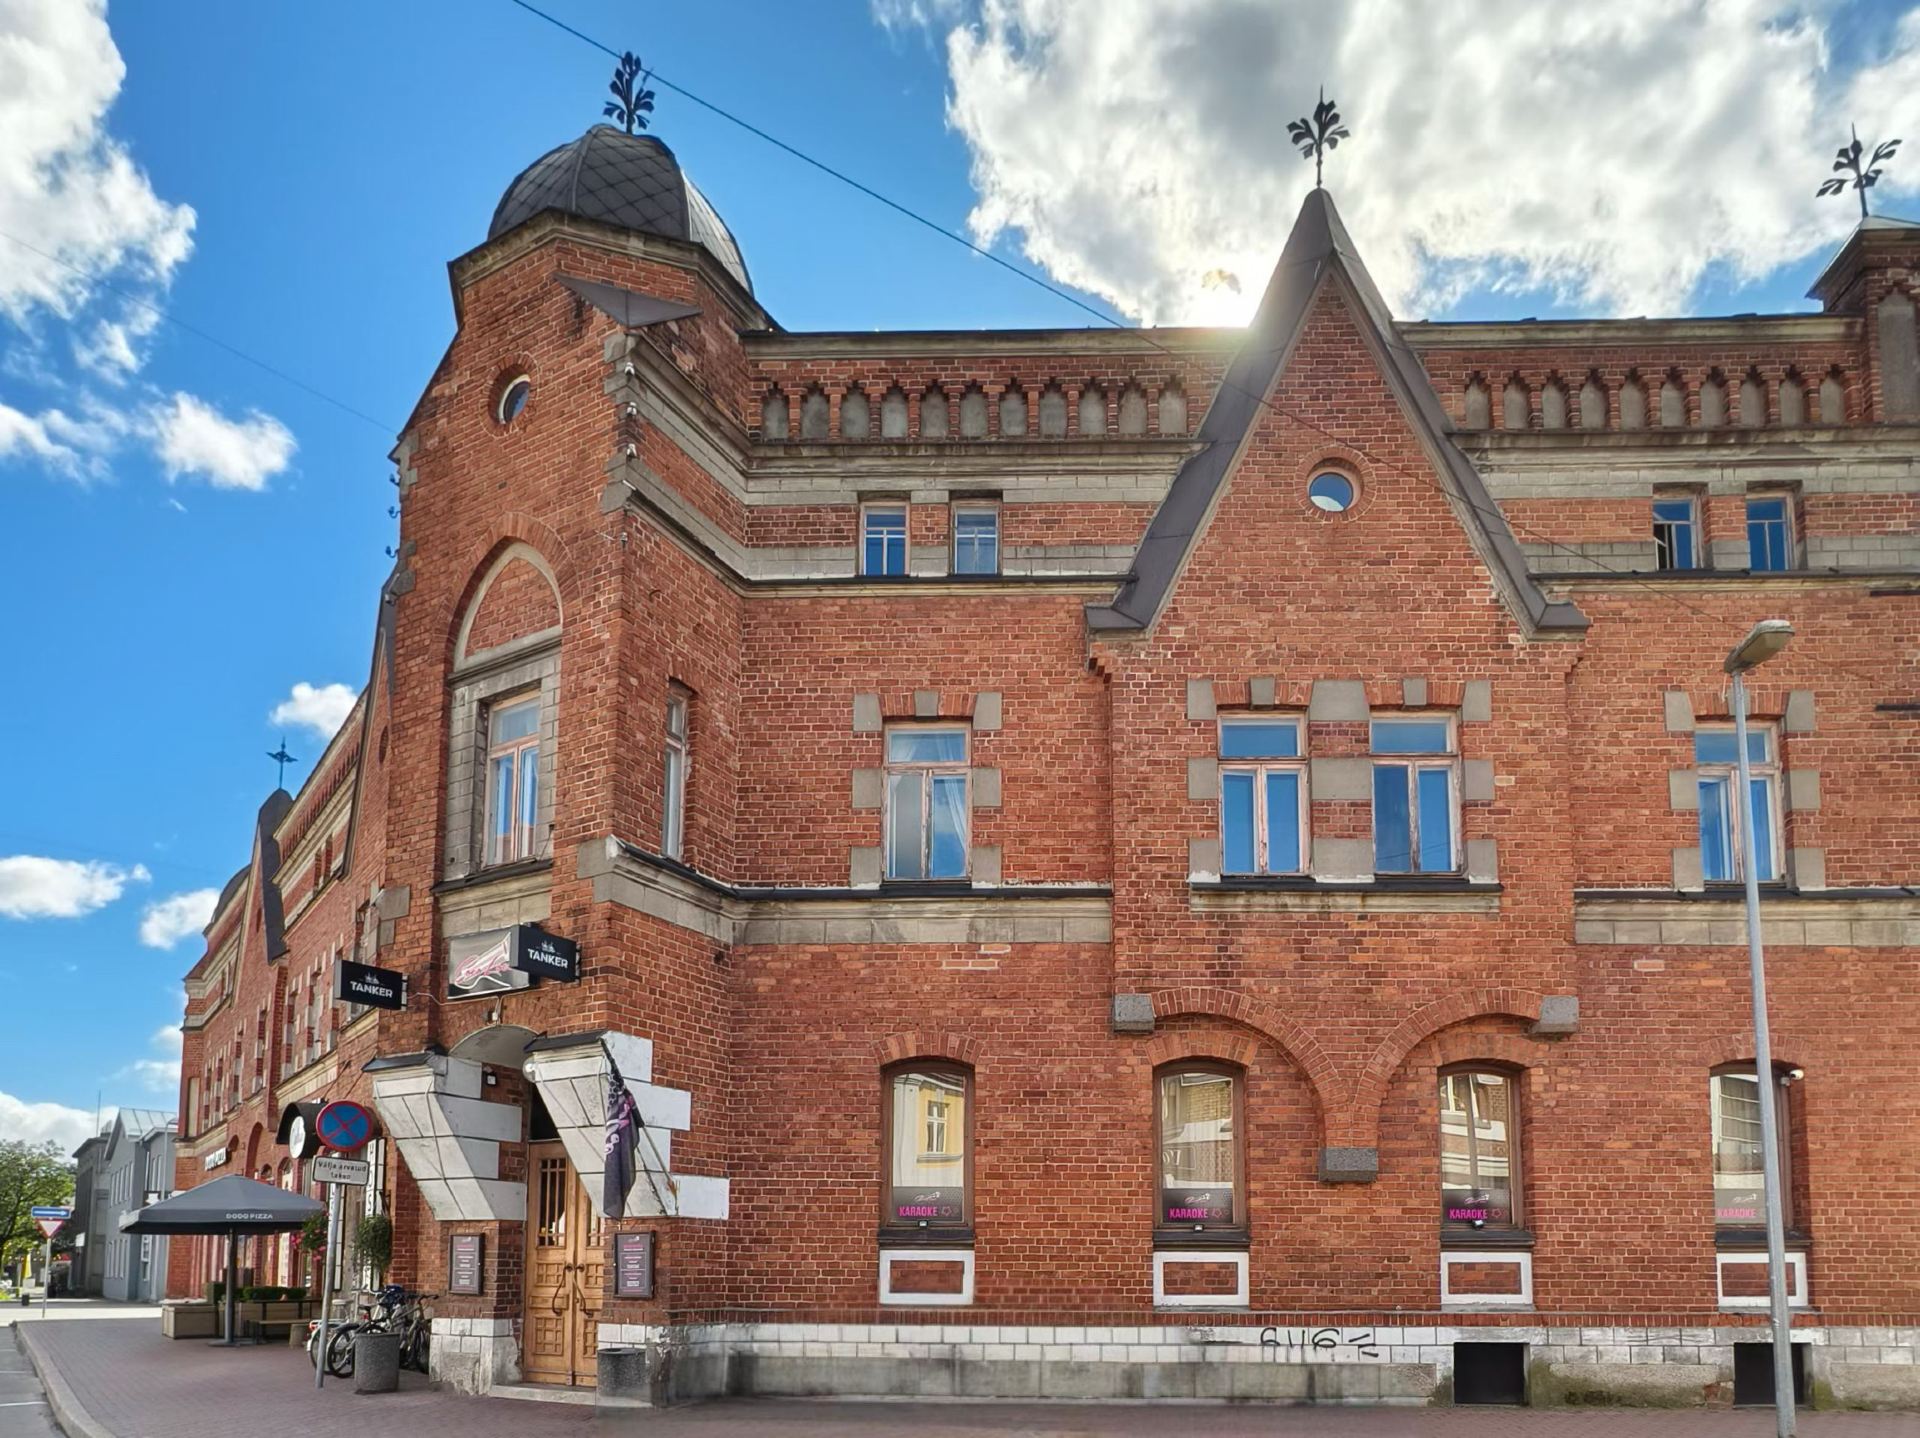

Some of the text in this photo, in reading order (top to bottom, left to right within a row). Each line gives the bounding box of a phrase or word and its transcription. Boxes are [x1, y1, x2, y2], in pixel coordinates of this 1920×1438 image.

[528, 948, 569, 969] TANKER
[350, 980, 393, 998] TANKER
[225, 1212, 273, 1220] DODO PIZZA
[899, 1206, 938, 1217] KARAOKE
[1169, 1207, 1208, 1219] KARAOKE
[1449, 1208, 1488, 1219] KARAOKE
[1716, 1207, 1756, 1218] KARAOKE
